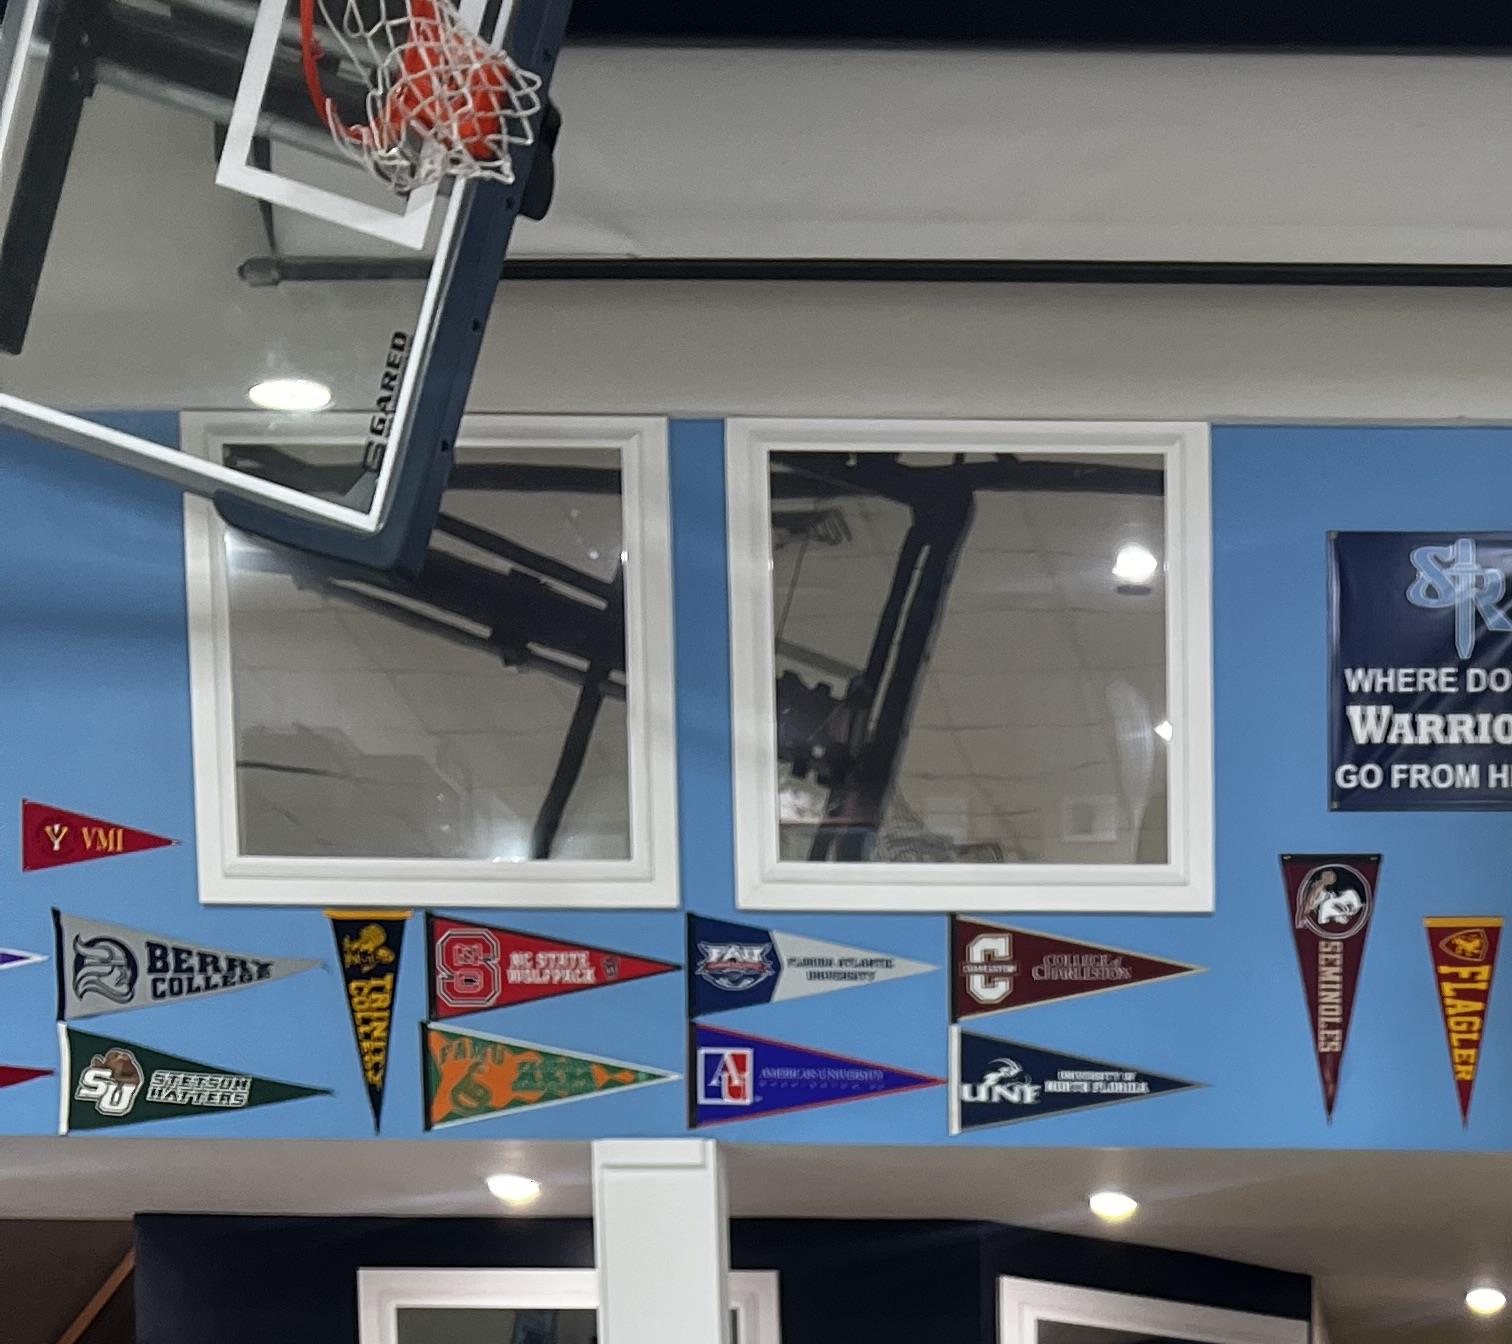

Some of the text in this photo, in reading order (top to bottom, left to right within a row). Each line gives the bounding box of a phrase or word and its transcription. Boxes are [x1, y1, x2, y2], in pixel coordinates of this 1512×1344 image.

[370, 331, 407, 436] GARED
[1344, 667, 1459, 693] WHERE
[1466, 667, 1512, 693] DO
[1335, 763, 1384, 789] GO
[1391, 764, 1480, 789] FROM
[81, 826, 125, 852] VMI
[145, 939, 275, 978] BERRY
[510, 951, 591, 971] NC STATE
[151, 971, 258, 1000] COLLEGE
[507, 968, 596, 985] WOLFPACK
[1317, 940, 1343, 1054] SEMINOLES
[371, 972, 394, 1089] TRINITY
[1437, 964, 1493, 1082] FLAGLER
[149, 1071, 250, 1090] STETSON
[962, 1082, 1042, 1104] UNF
[148, 1087, 249, 1106] HATTERS
